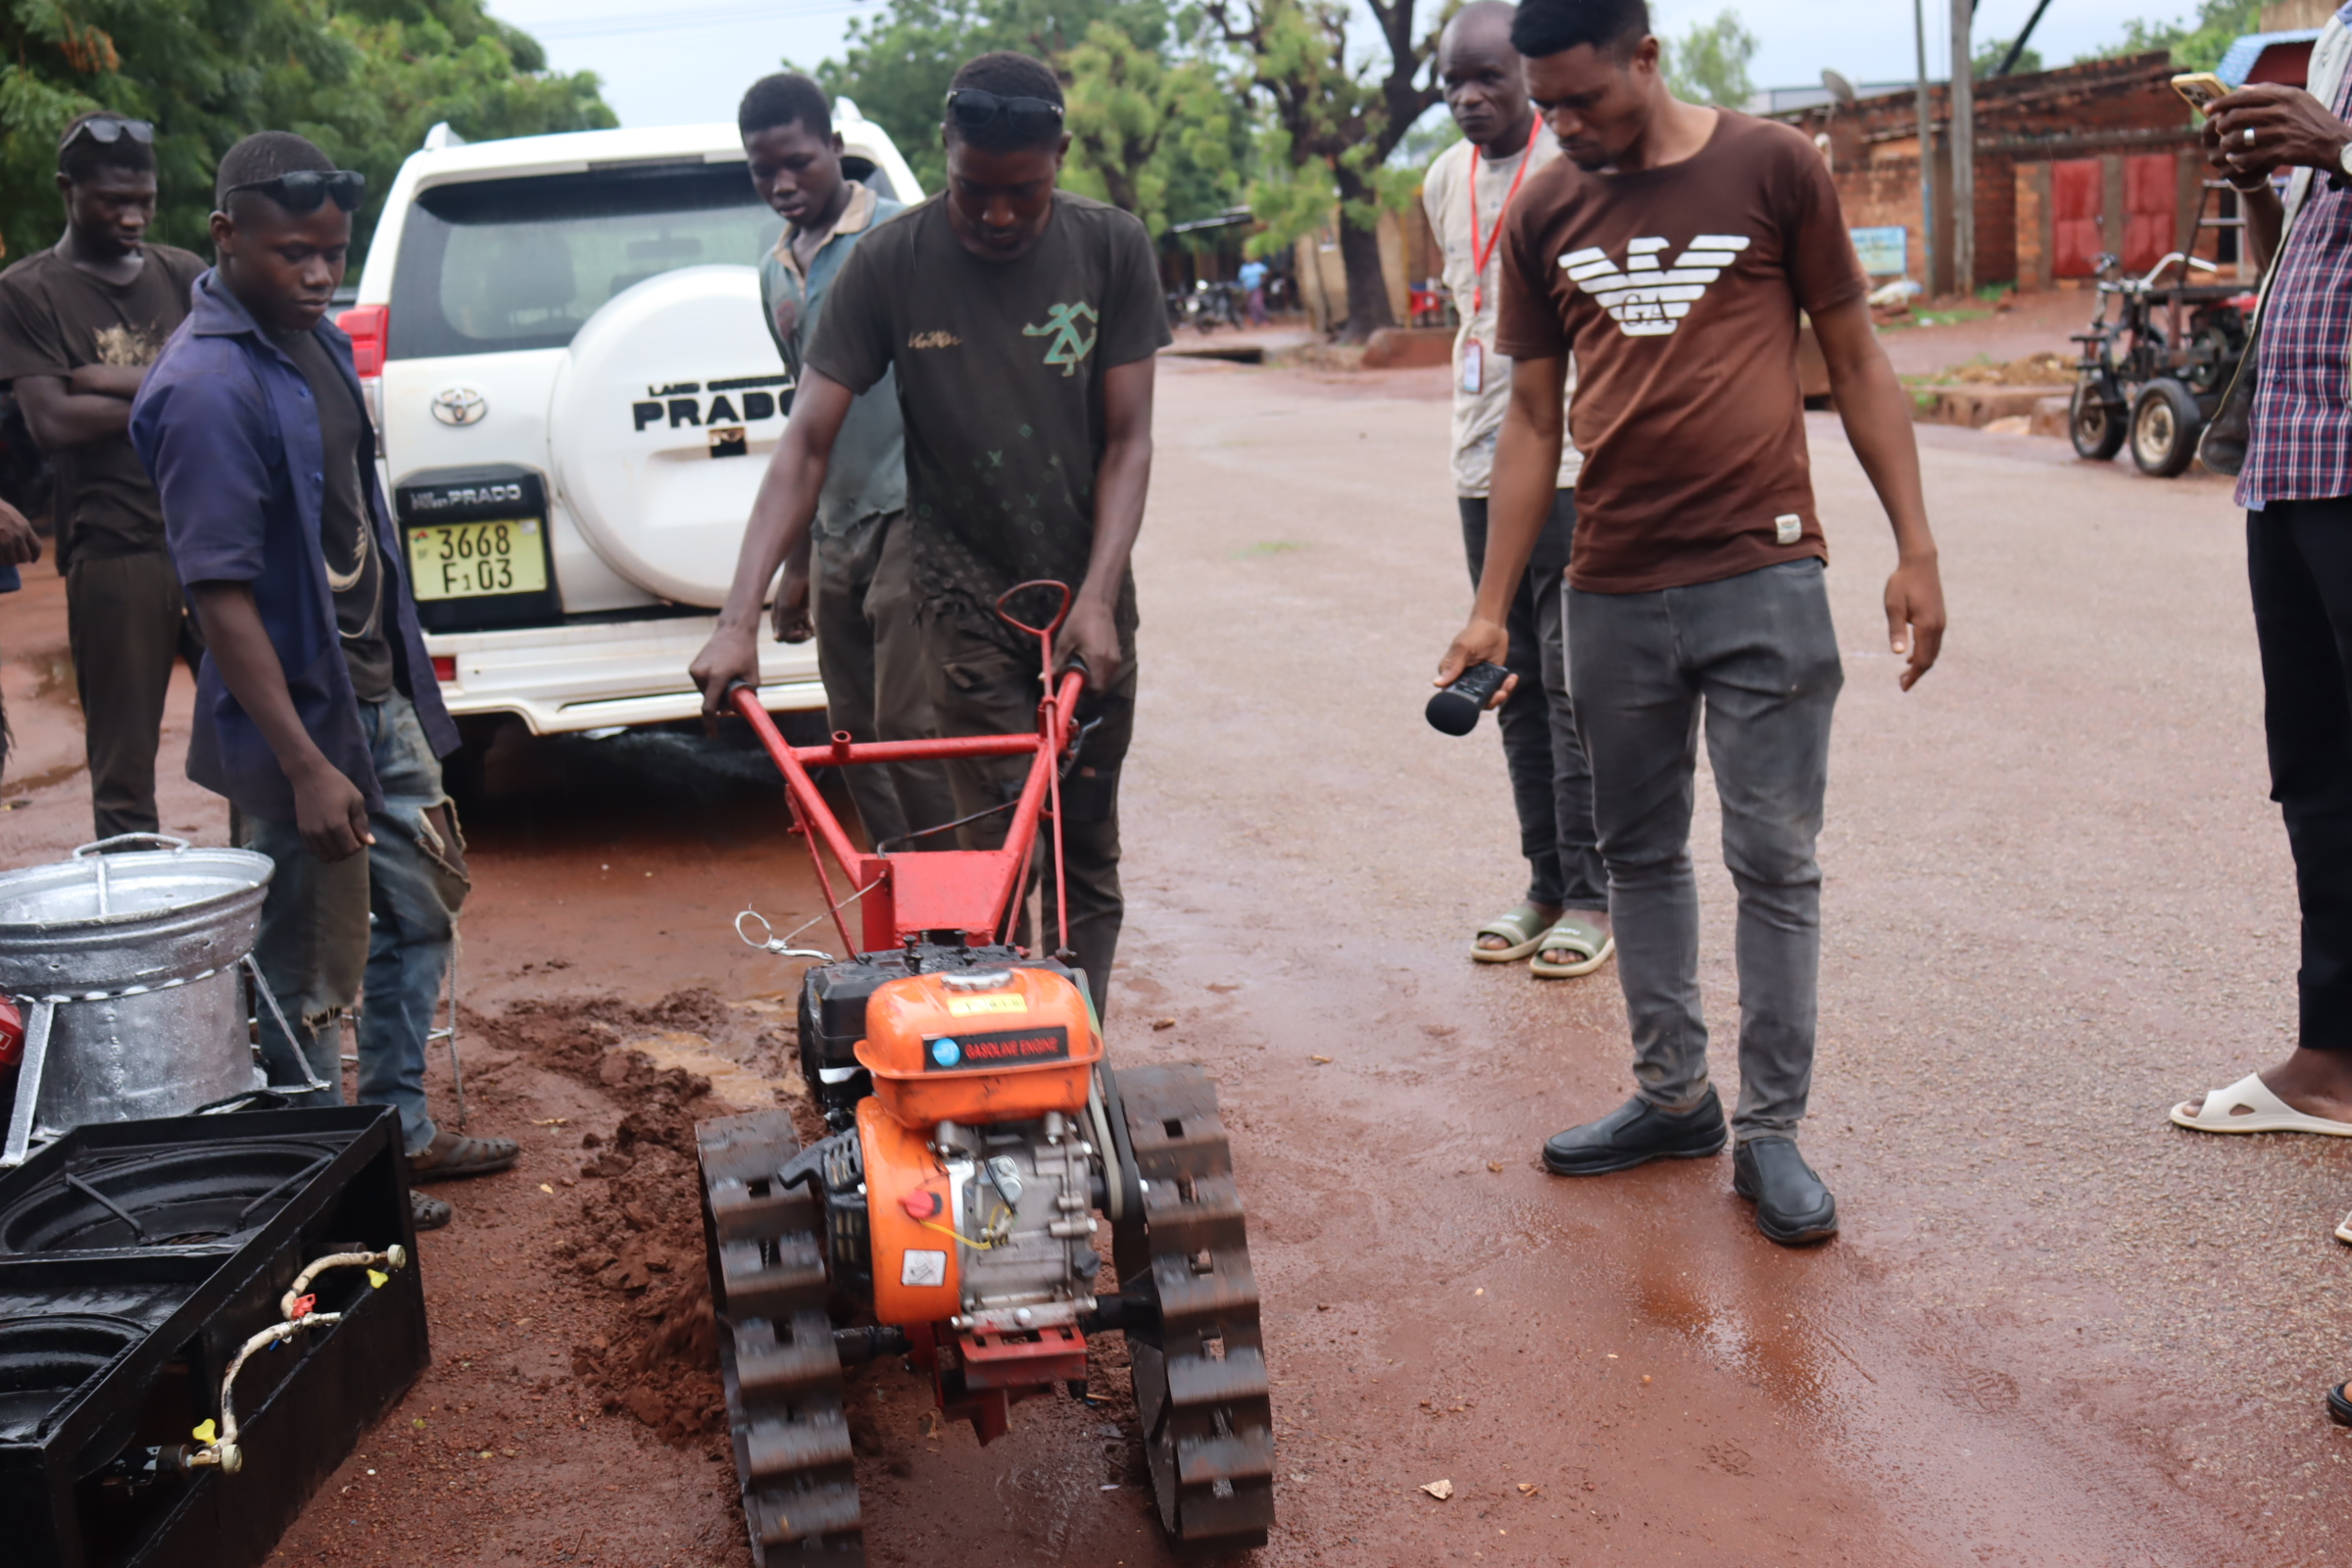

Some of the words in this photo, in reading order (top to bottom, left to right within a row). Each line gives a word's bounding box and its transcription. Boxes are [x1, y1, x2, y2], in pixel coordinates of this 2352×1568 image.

[1622, 292, 1673, 326] GA
[448, 484, 521, 506] PRADO
[436, 524, 511, 560] 3668
[965, 1040, 1019, 1059] GASOLINE
[1019, 1037, 1058, 1055] ENGINE
